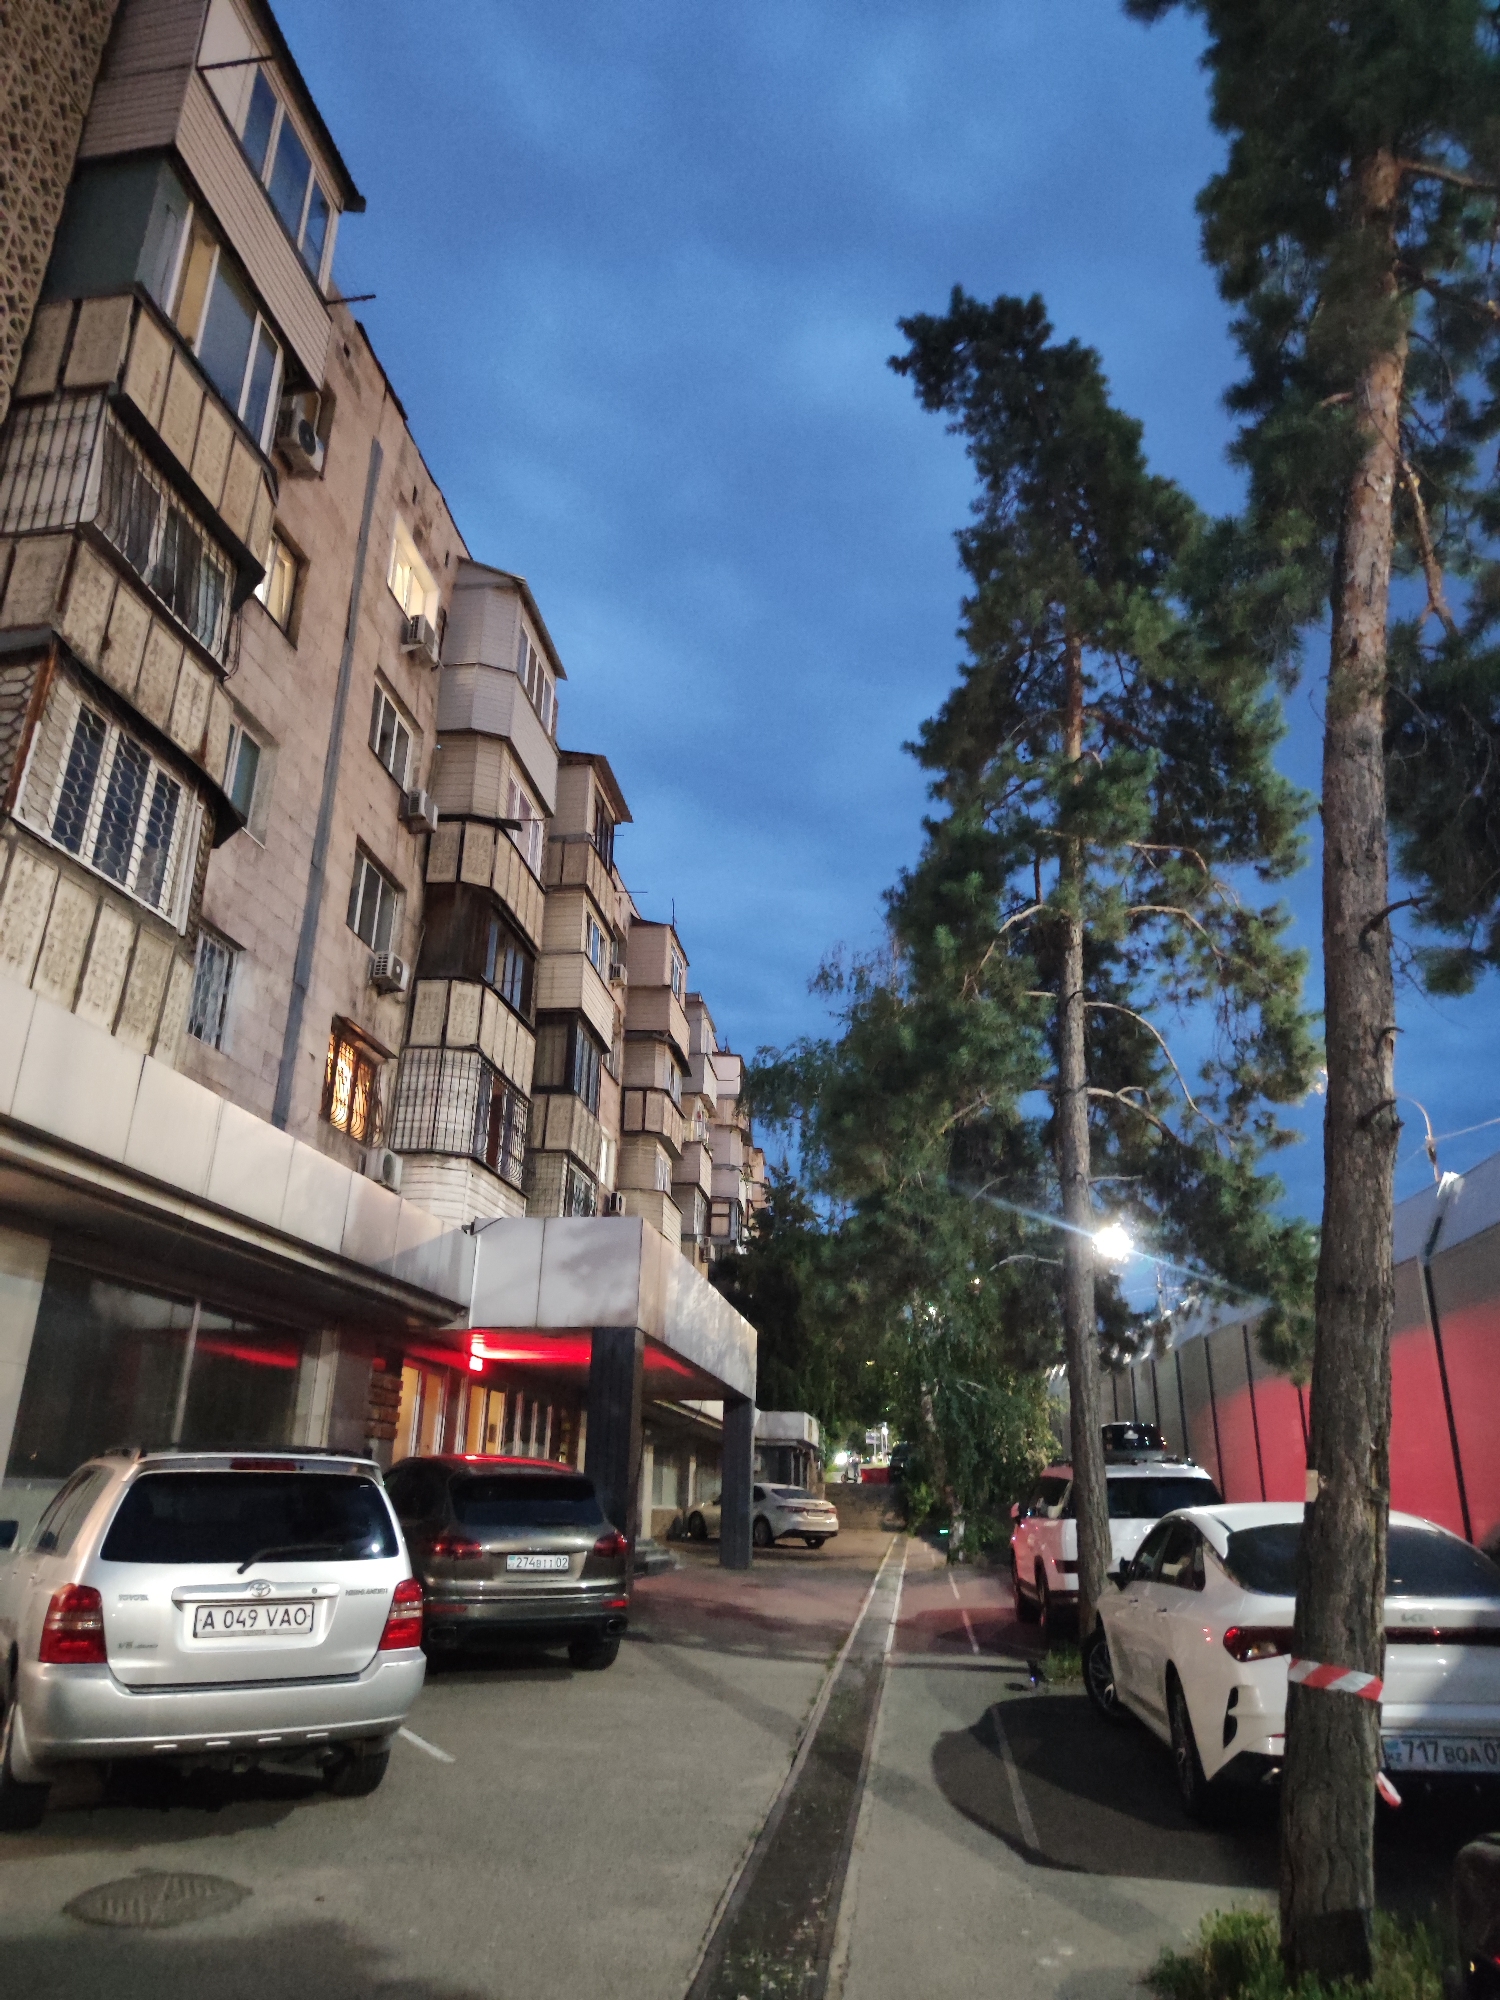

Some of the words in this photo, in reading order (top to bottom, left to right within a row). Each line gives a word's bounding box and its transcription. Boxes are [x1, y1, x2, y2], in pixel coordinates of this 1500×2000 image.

[202, 1610, 215, 1630] A
[223, 1609, 259, 1629] 049
[266, 1607, 307, 1627] VAO
